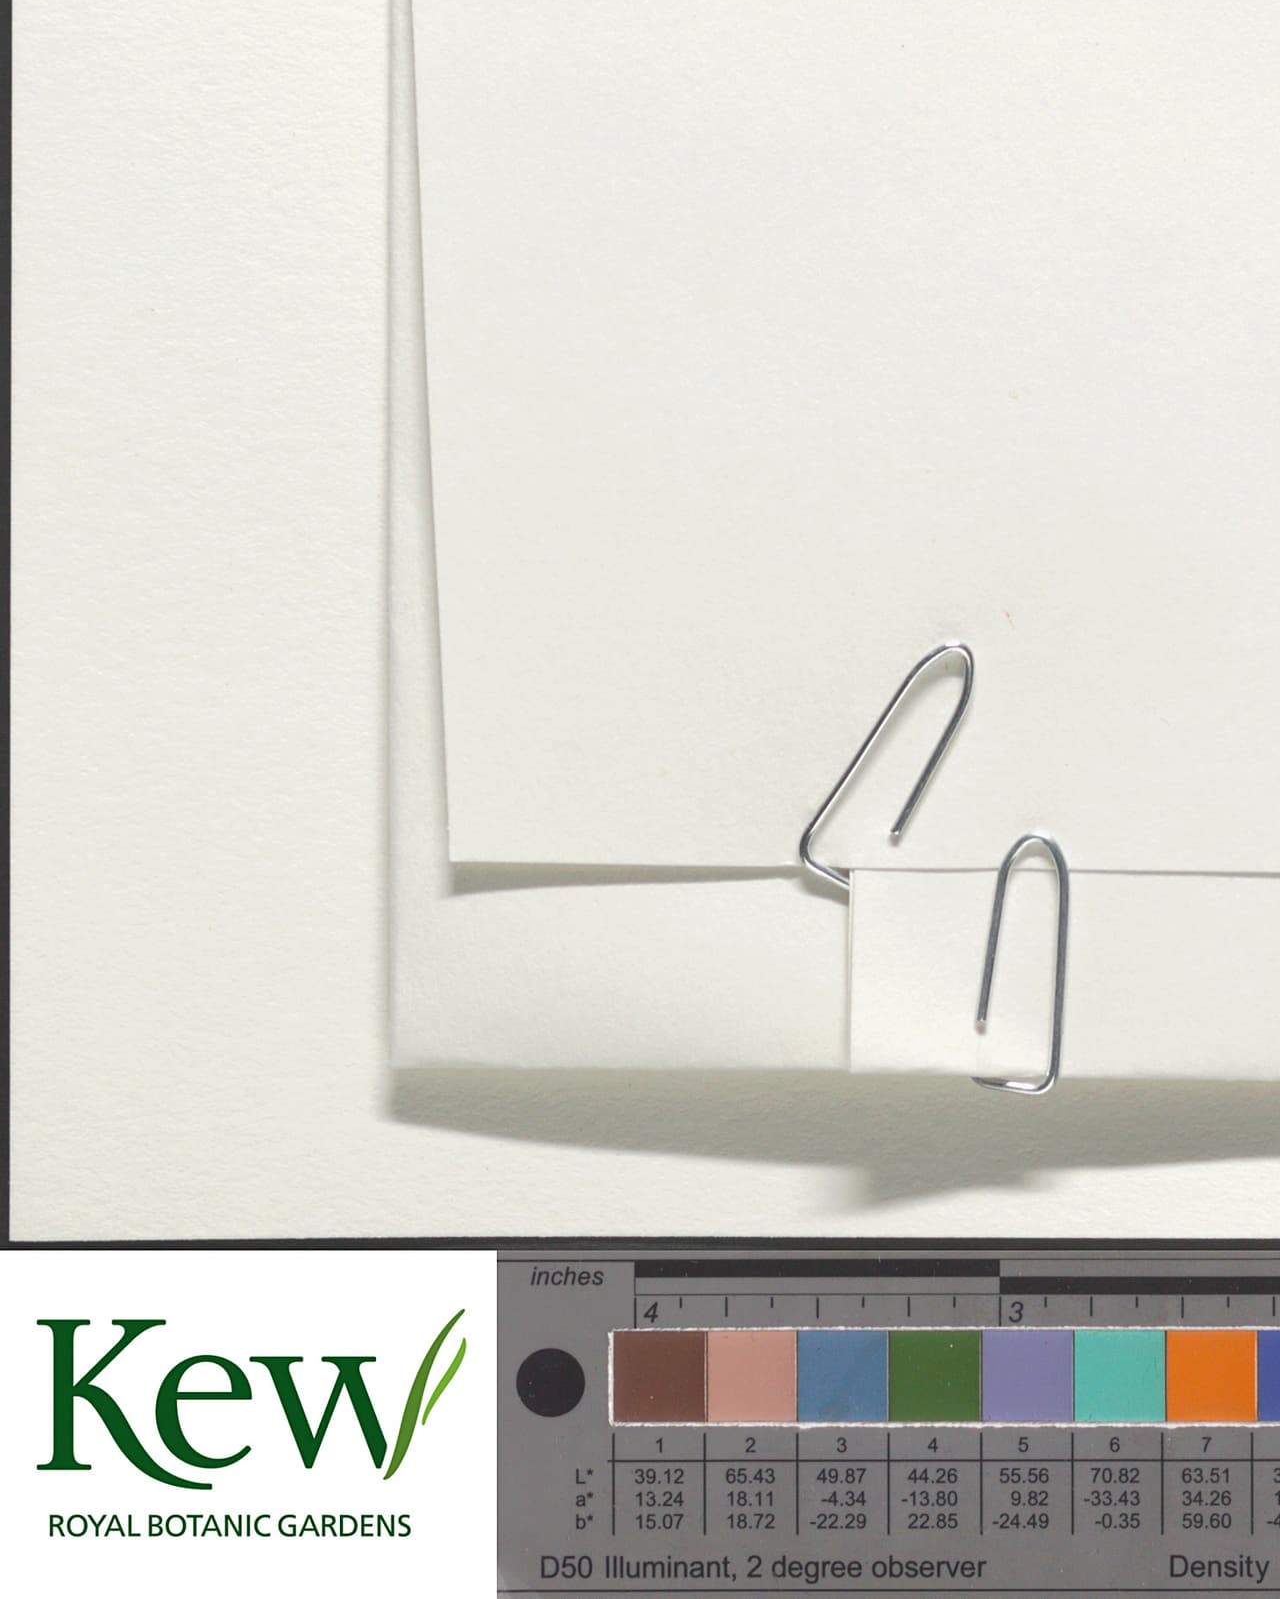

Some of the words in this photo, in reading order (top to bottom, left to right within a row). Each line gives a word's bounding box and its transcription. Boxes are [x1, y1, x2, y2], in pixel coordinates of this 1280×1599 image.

[530, 1265, 605, 1286] inches
[643, 1301, 659, 1324] 4
[1008, 1300, 1024, 1324] 3
[655, 1437, 663, 1454] 1
[744, 1436, 757, 1454] 2
[836, 1436, 848, 1454] 3
[927, 1437, 939, 1453] 4
[1018, 1436, 1030, 1453] 5
[1109, 1436, 1121, 1453] 6
[1201, 1436, 1213, 1453] 7
[634, 1467, 685, 1485] 39.12
[725, 1467, 776, 1485] 65.43
[816, 1467, 867, 1485] 49.87
[907, 1467, 958, 1484] 44.26
[999, 1467, 1050, 1484] 55.56
[1090, 1467, 1140, 1484] 70.82
[1181, 1467, 1230, 1484] 63.51
[540, 1555, 593, 1580] D50
[605, 1555, 737, 1582] Illuminant,
[746, 1554, 763, 1579] 2
[771, 1554, 863, 1585] degree
[871, 1554, 988, 1579] observer
[1169, 1554, 1270, 1585] Density
